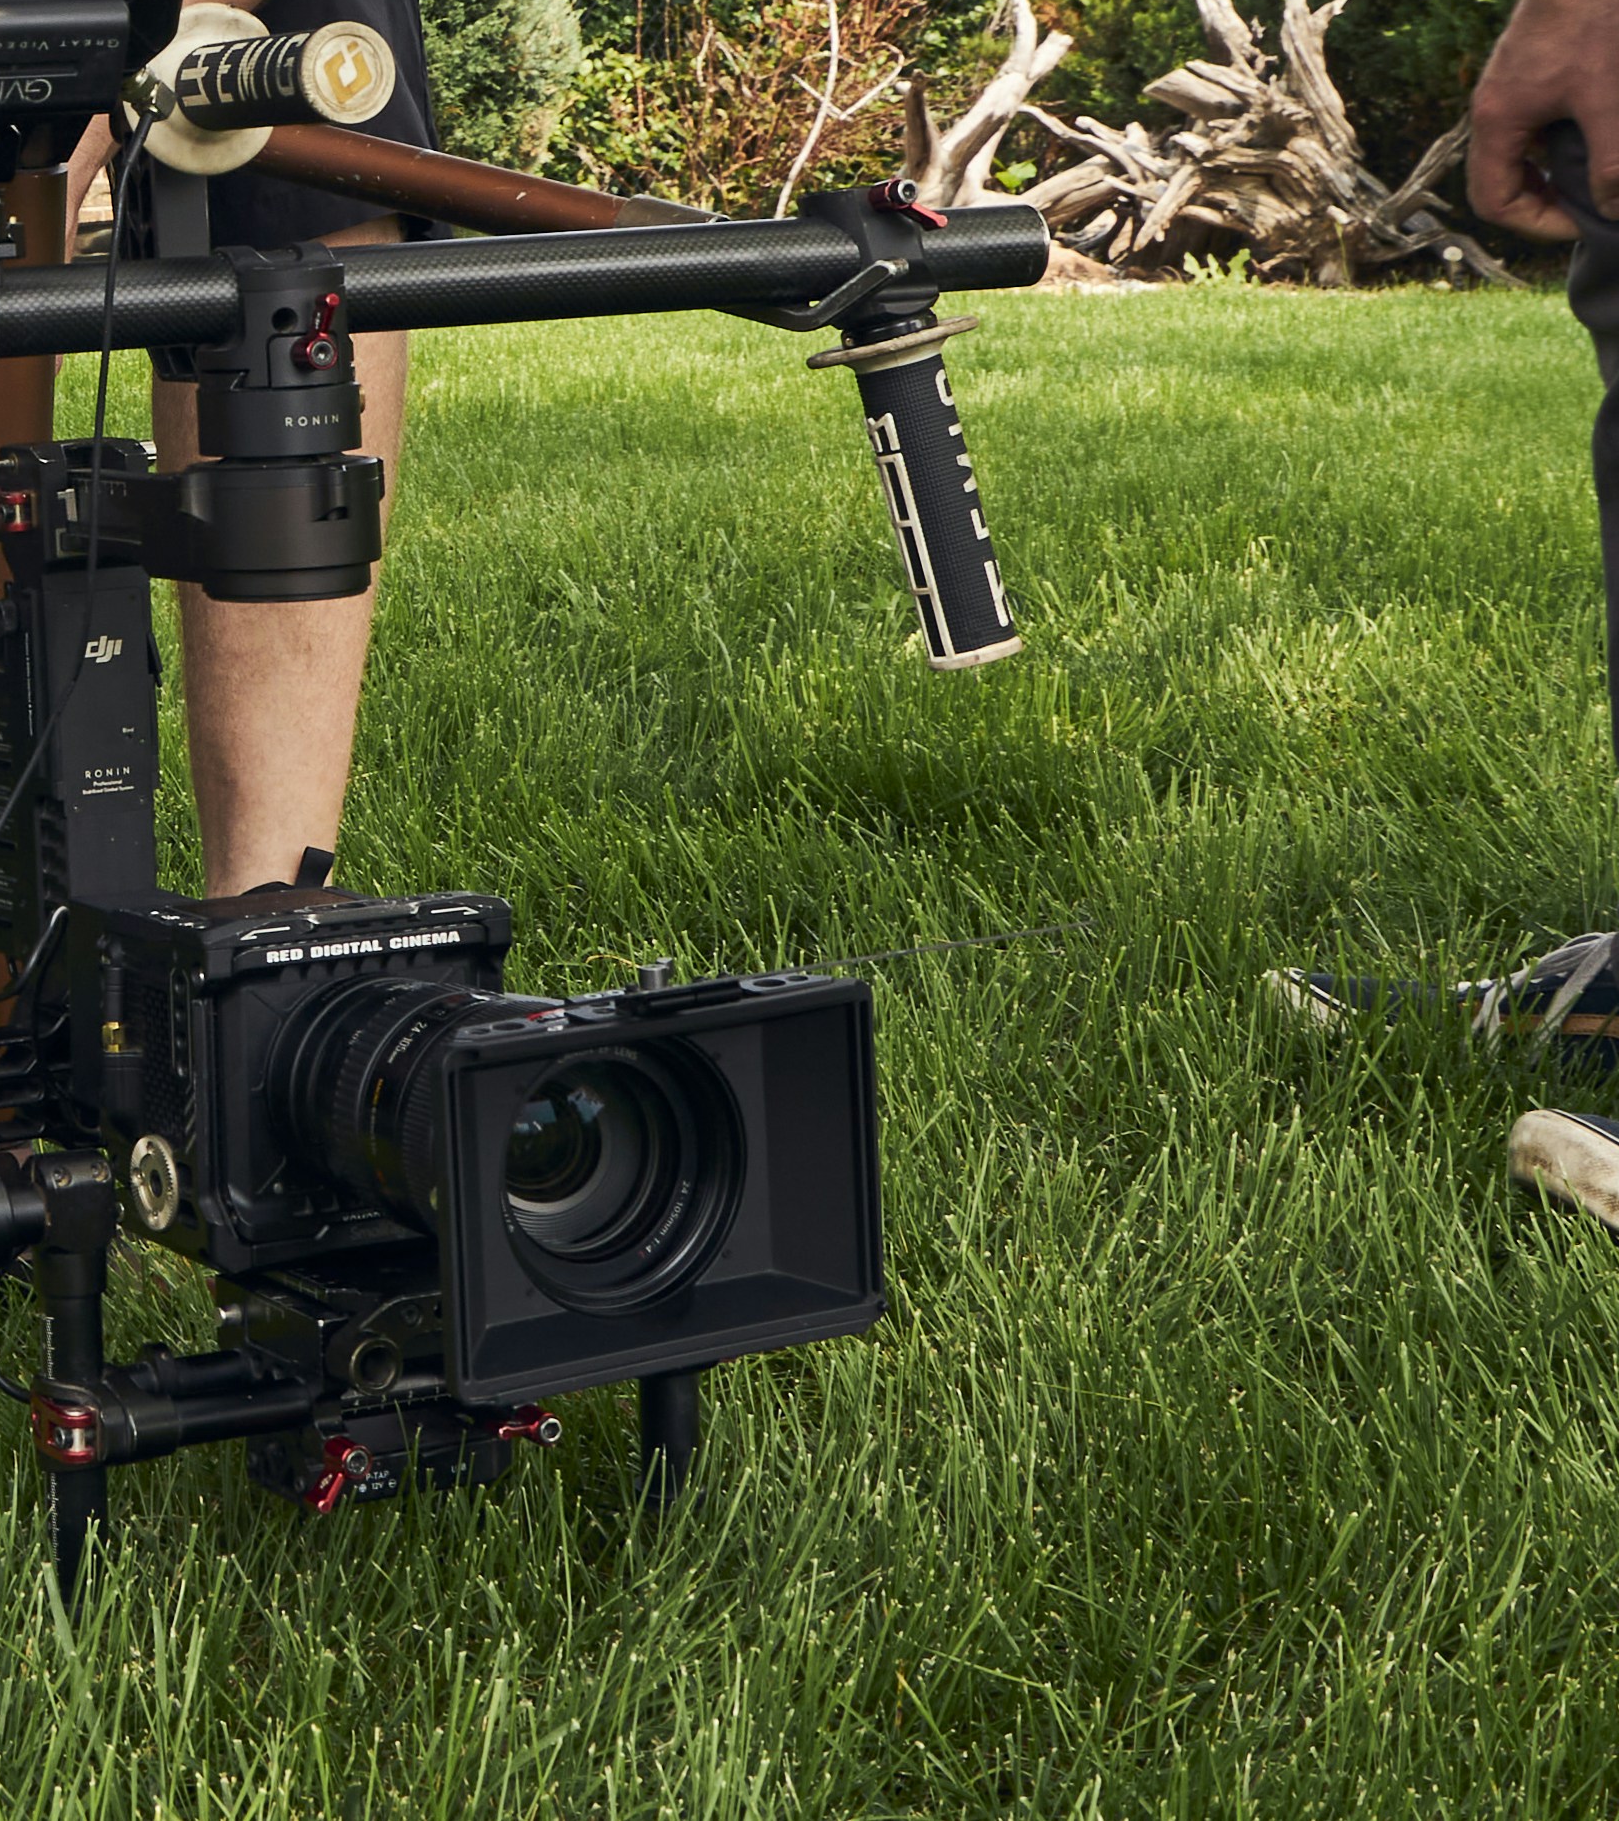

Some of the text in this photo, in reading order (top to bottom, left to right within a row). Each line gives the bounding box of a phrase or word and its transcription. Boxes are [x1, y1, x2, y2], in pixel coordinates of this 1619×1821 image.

[284, 413, 340, 428] RONIN
[84, 765, 131, 779] RONIN
[266, 930, 461, 964] RED DIGITAL CINEMA
[450, 1462, 468, 1474] UB
